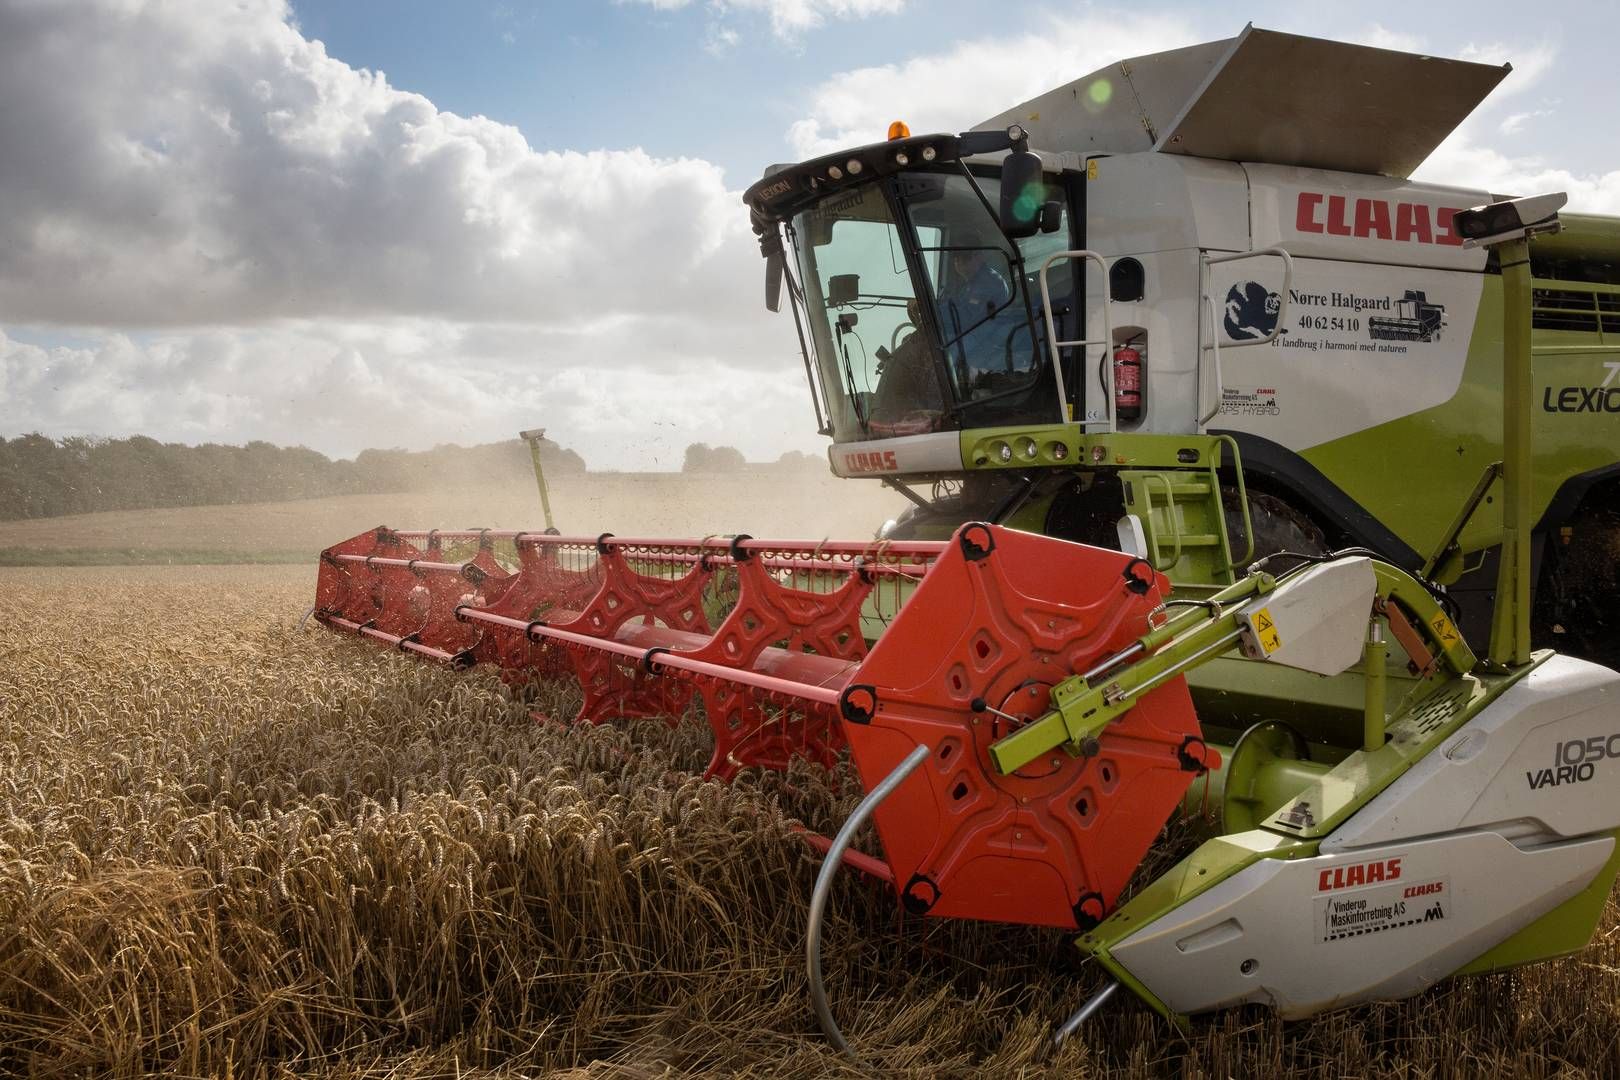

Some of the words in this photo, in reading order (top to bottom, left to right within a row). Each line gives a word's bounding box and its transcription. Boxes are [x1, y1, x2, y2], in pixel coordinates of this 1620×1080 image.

[1296, 192, 1465, 247] CLAAS
[1288, 289, 1328, 307] Nørre
[1331, 292, 1391, 312] Halgaard
[1298, 314, 1313, 330] 40
[1314, 315, 1329, 330] 62
[1330, 317, 1344, 331] 54
[1347, 318, 1360, 331] 10
[1282, 338, 1318, 351] landbrug
[1325, 340, 1358, 351] harmoni
[1360, 342, 1376, 352] med
[1378, 343, 1407, 353] naturen
[1242, 407, 1280, 416] HYBRID
[844, 451, 898, 472] CLAAS
[1526, 762, 1595, 790] VARIO
[1319, 858, 1401, 891] CLAAS
[1404, 882, 1443, 899] CLAAS
[1331, 905, 1393, 928] Maskinforretning
[1333, 899, 1367, 914] Vinderup
